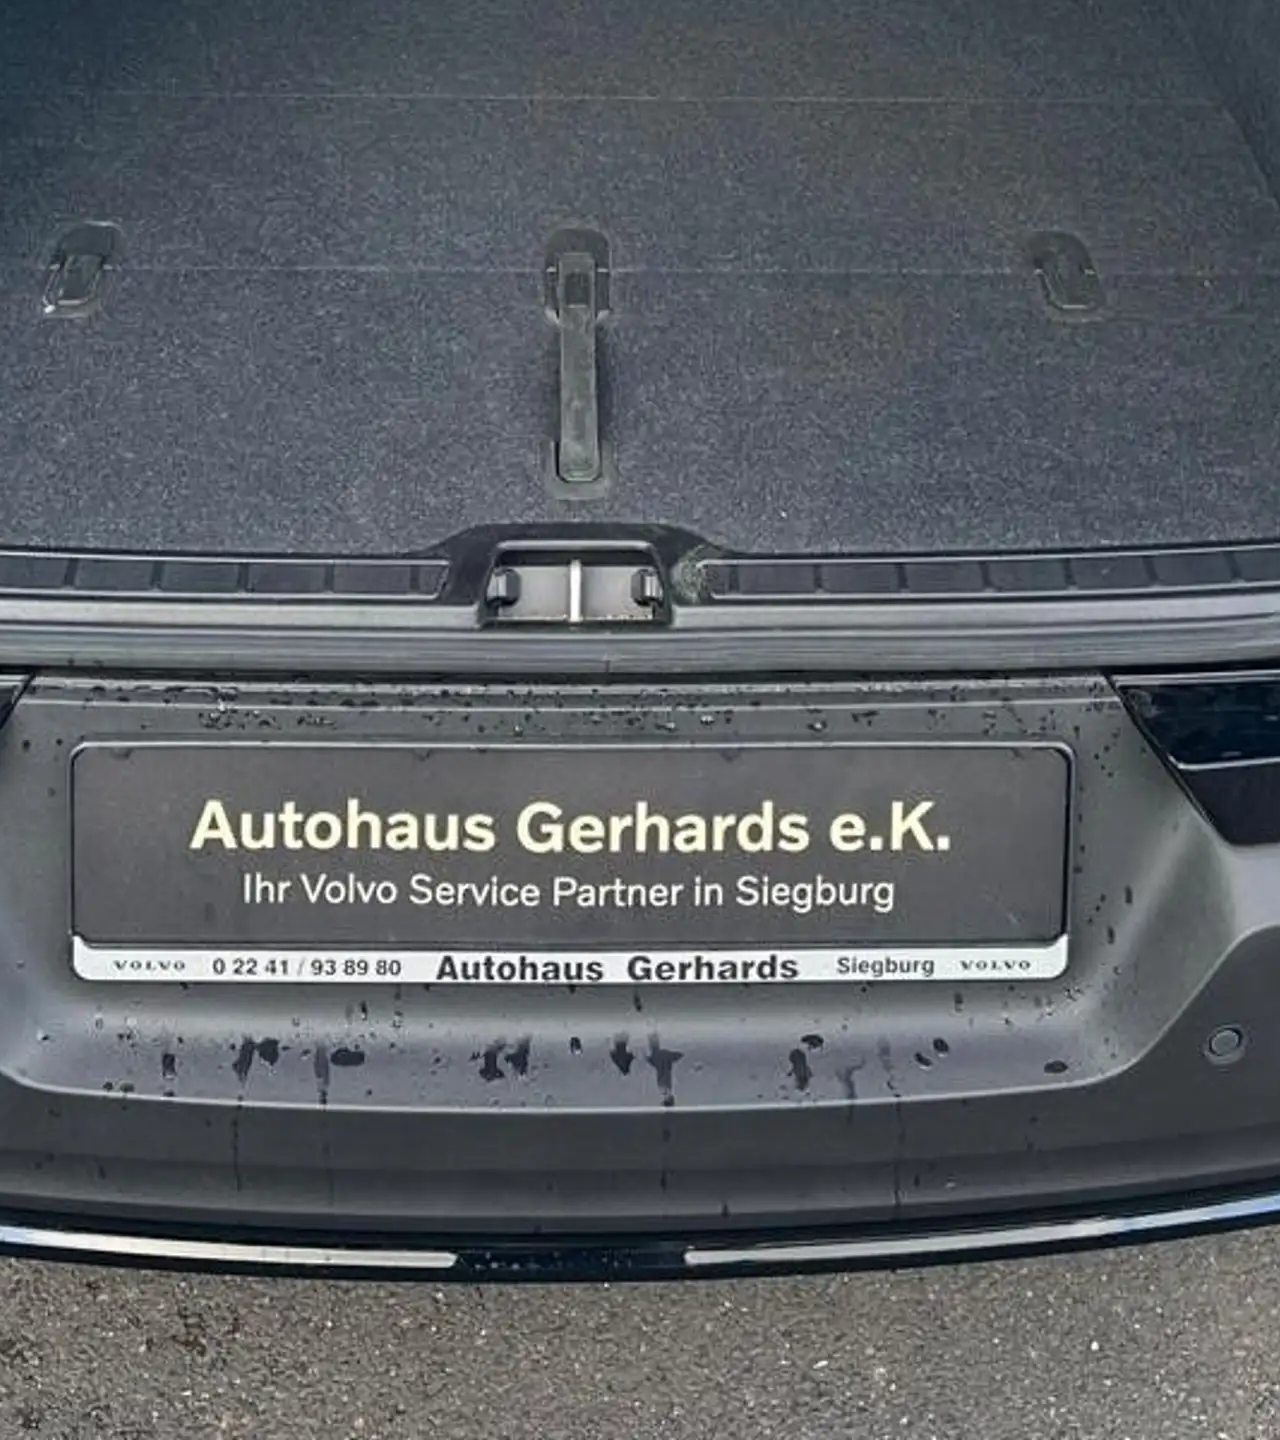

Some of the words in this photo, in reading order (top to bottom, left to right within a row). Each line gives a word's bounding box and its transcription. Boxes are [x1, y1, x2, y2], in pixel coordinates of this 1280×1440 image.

[189, 797, 496, 853] Autohaus
[517, 800, 811, 853] Gerhards
[829, 800, 951, 852] e.K.
[243, 873, 291, 904] Ihr
[299, 873, 398, 905] Volvo
[409, 873, 541, 907] Service
[553, 875, 684, 907] Partner
[694, 876, 723, 906] in
[735, 874, 895, 914] Siegburg
[113, 959, 186, 971] VOLVO
[212, 957, 225, 976] 0
[232, 958, 258, 976] 22
[265, 958, 289, 976] 41
[310, 959, 336, 976] 93
[343, 959, 368, 976] 89
[375, 959, 402, 976] 80
[435, 956, 604, 982] Autohaus
[627, 955, 800, 982] Gerhards
[836, 957, 935, 978] Siegburg
[959, 960, 1032, 971] VOLVO
